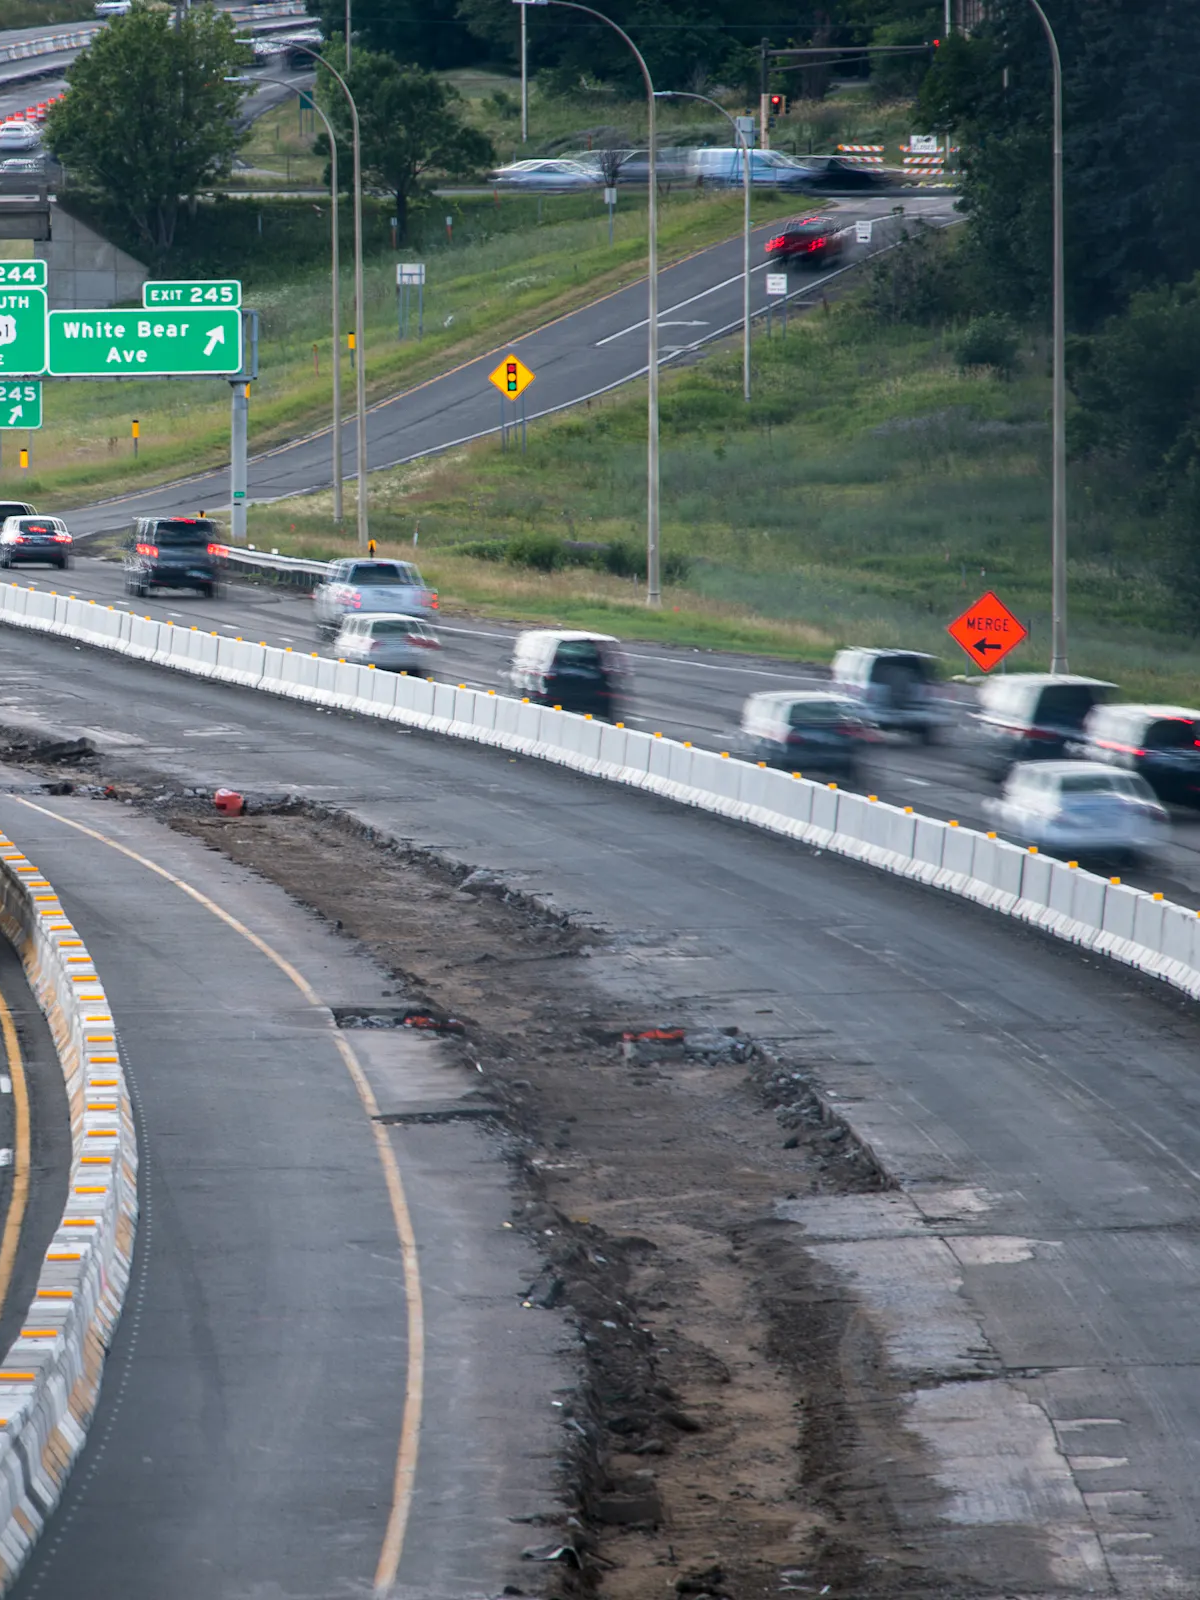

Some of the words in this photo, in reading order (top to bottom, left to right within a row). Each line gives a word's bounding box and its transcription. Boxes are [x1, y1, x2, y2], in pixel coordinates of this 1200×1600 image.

[151, 289, 183, 301] EXIT
[190, 287, 234, 303] 245
[63, 321, 126, 339] White
[137, 321, 189, 338] Bear
[106, 347, 148, 364] Ave
[967, 617, 1010, 632] MERGE
